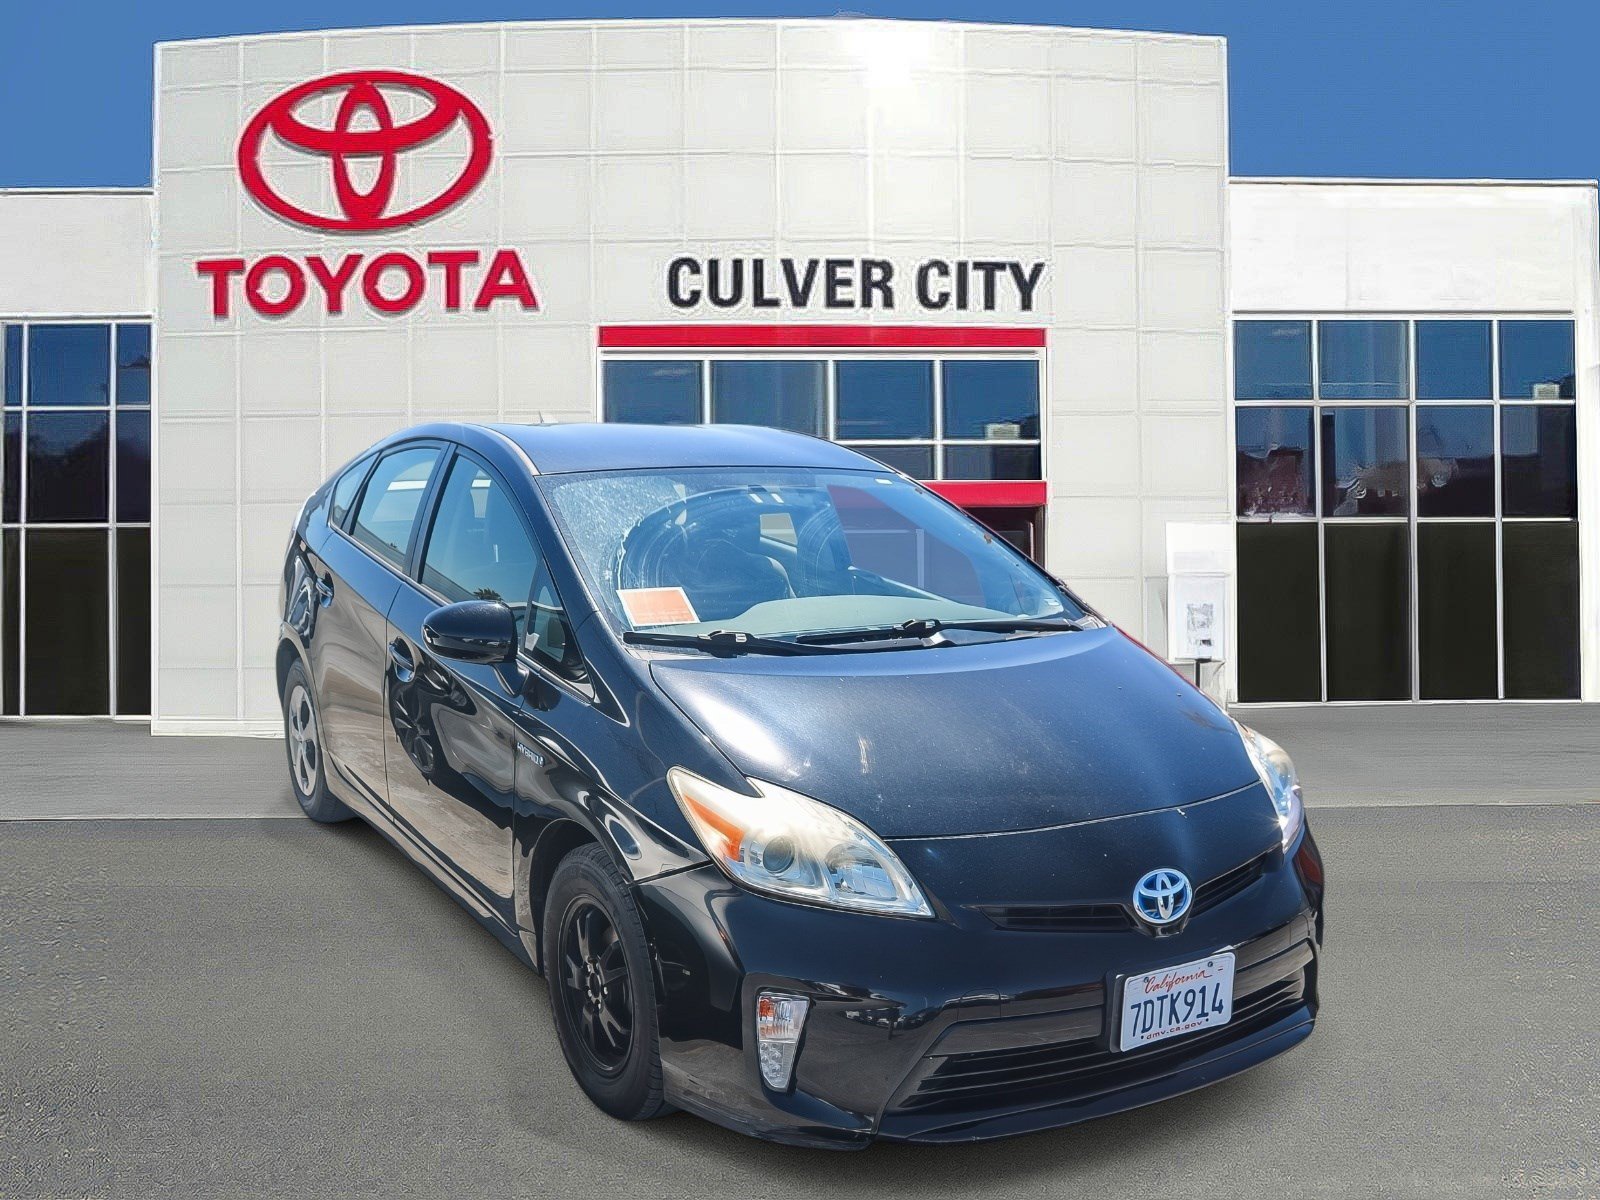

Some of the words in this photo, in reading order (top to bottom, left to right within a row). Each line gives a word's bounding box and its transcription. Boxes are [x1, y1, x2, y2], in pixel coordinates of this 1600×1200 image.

[195, 249, 539, 318] TOYOTA
[667, 256, 895, 310] CULVER
[915, 258, 1045, 311] CITY
[1144, 969, 1213, 994] California
[1130, 982, 1224, 1038] 7DTK914
[1146, 1019, 1203, 1041] dmv.ca.gov
